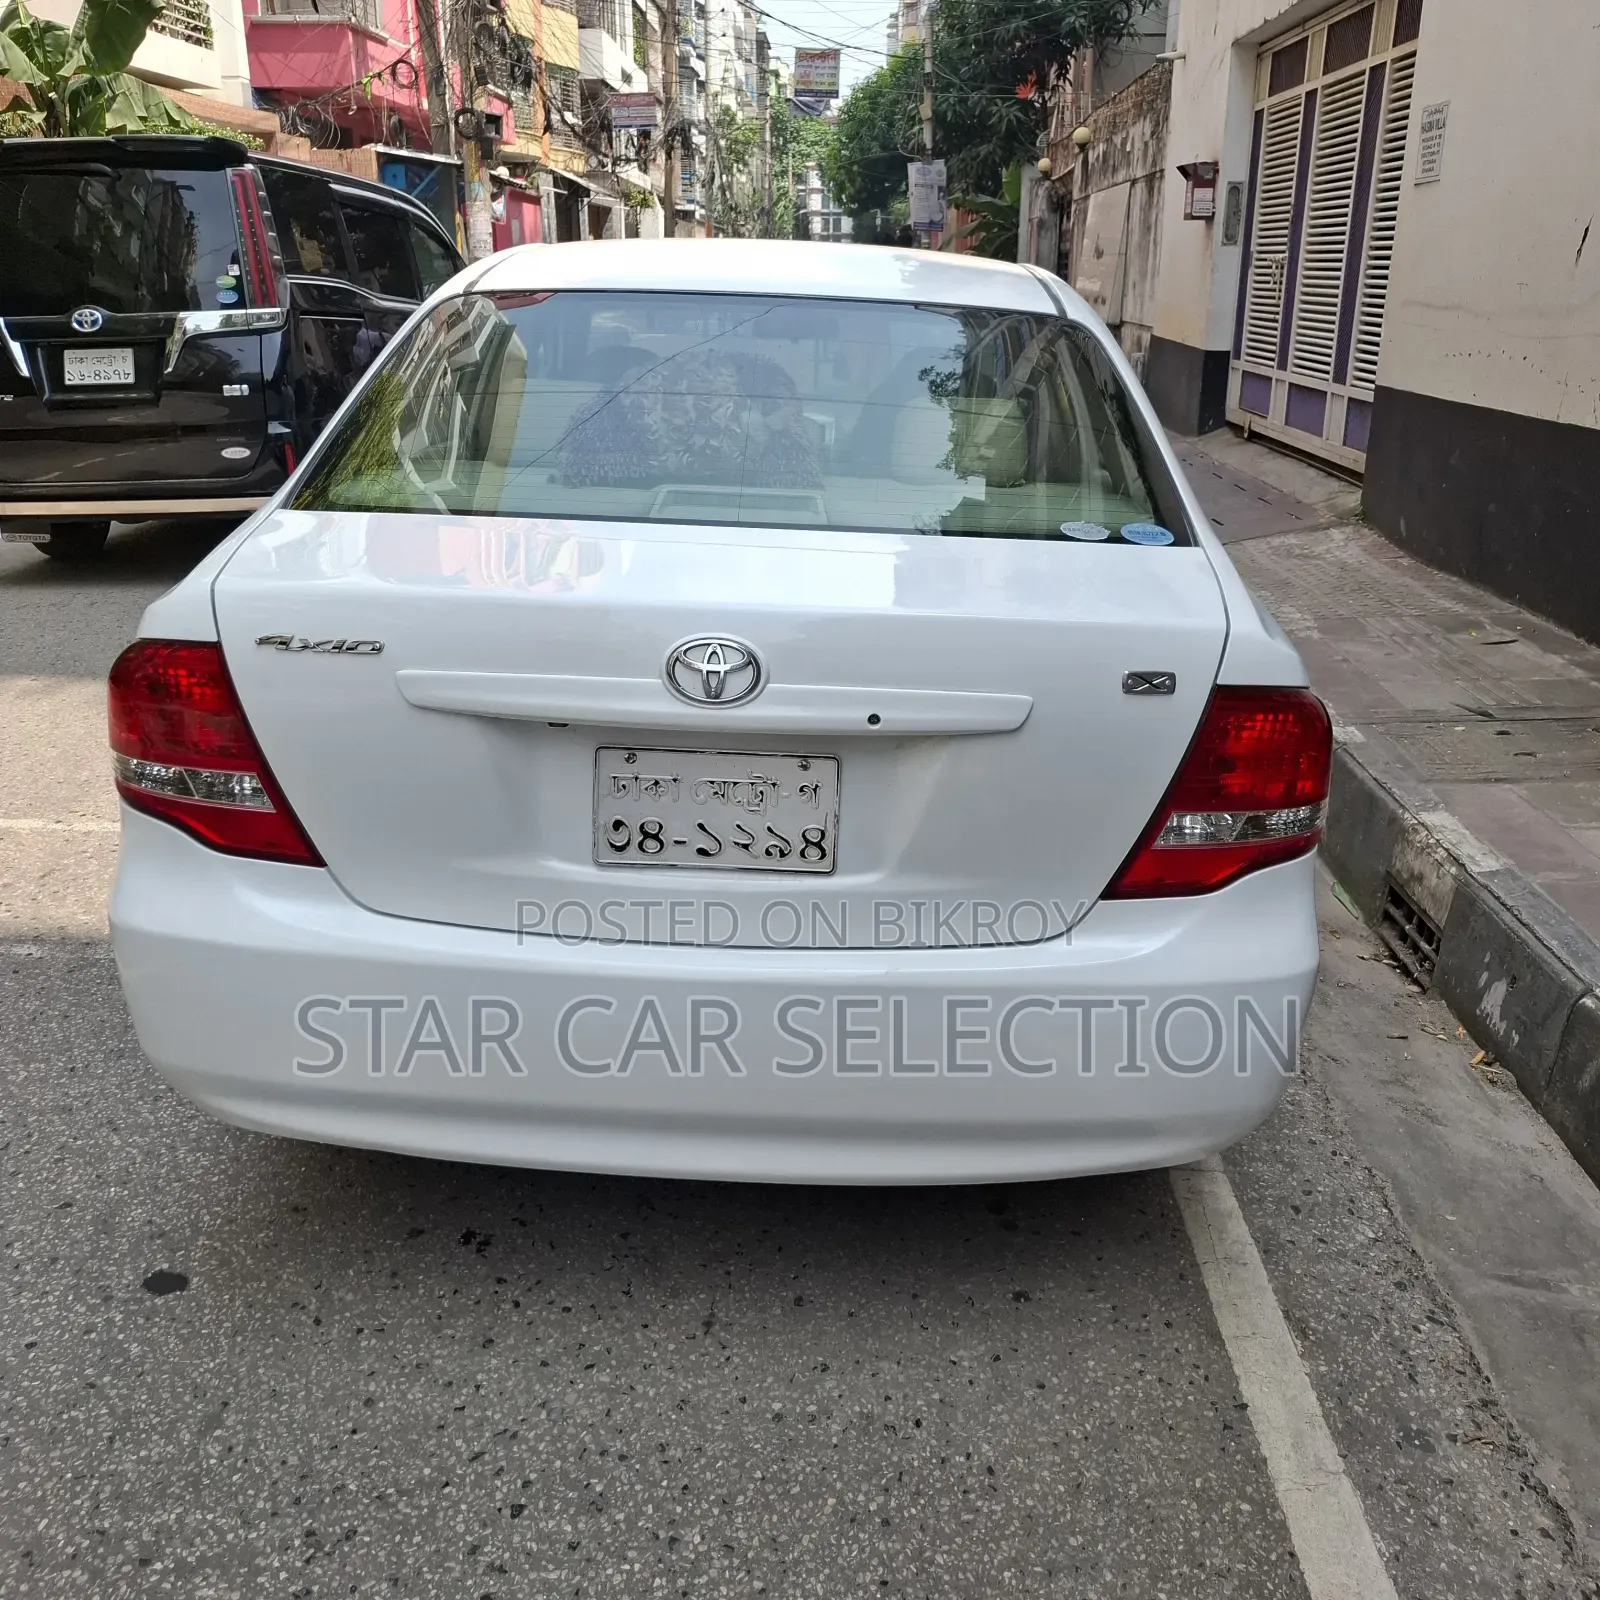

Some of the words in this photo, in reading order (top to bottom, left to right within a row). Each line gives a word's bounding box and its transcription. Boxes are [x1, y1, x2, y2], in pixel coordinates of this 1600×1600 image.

[68, 356, 88, 365] ঢাকা
[67, 369, 132, 382] ১৬-৪৯৭৮
[254, 633, 386, 654] AXIO
[609, 771, 682, 803] ঢাকা
[603, 815, 829, 862] ৩৪-১২৯৪
